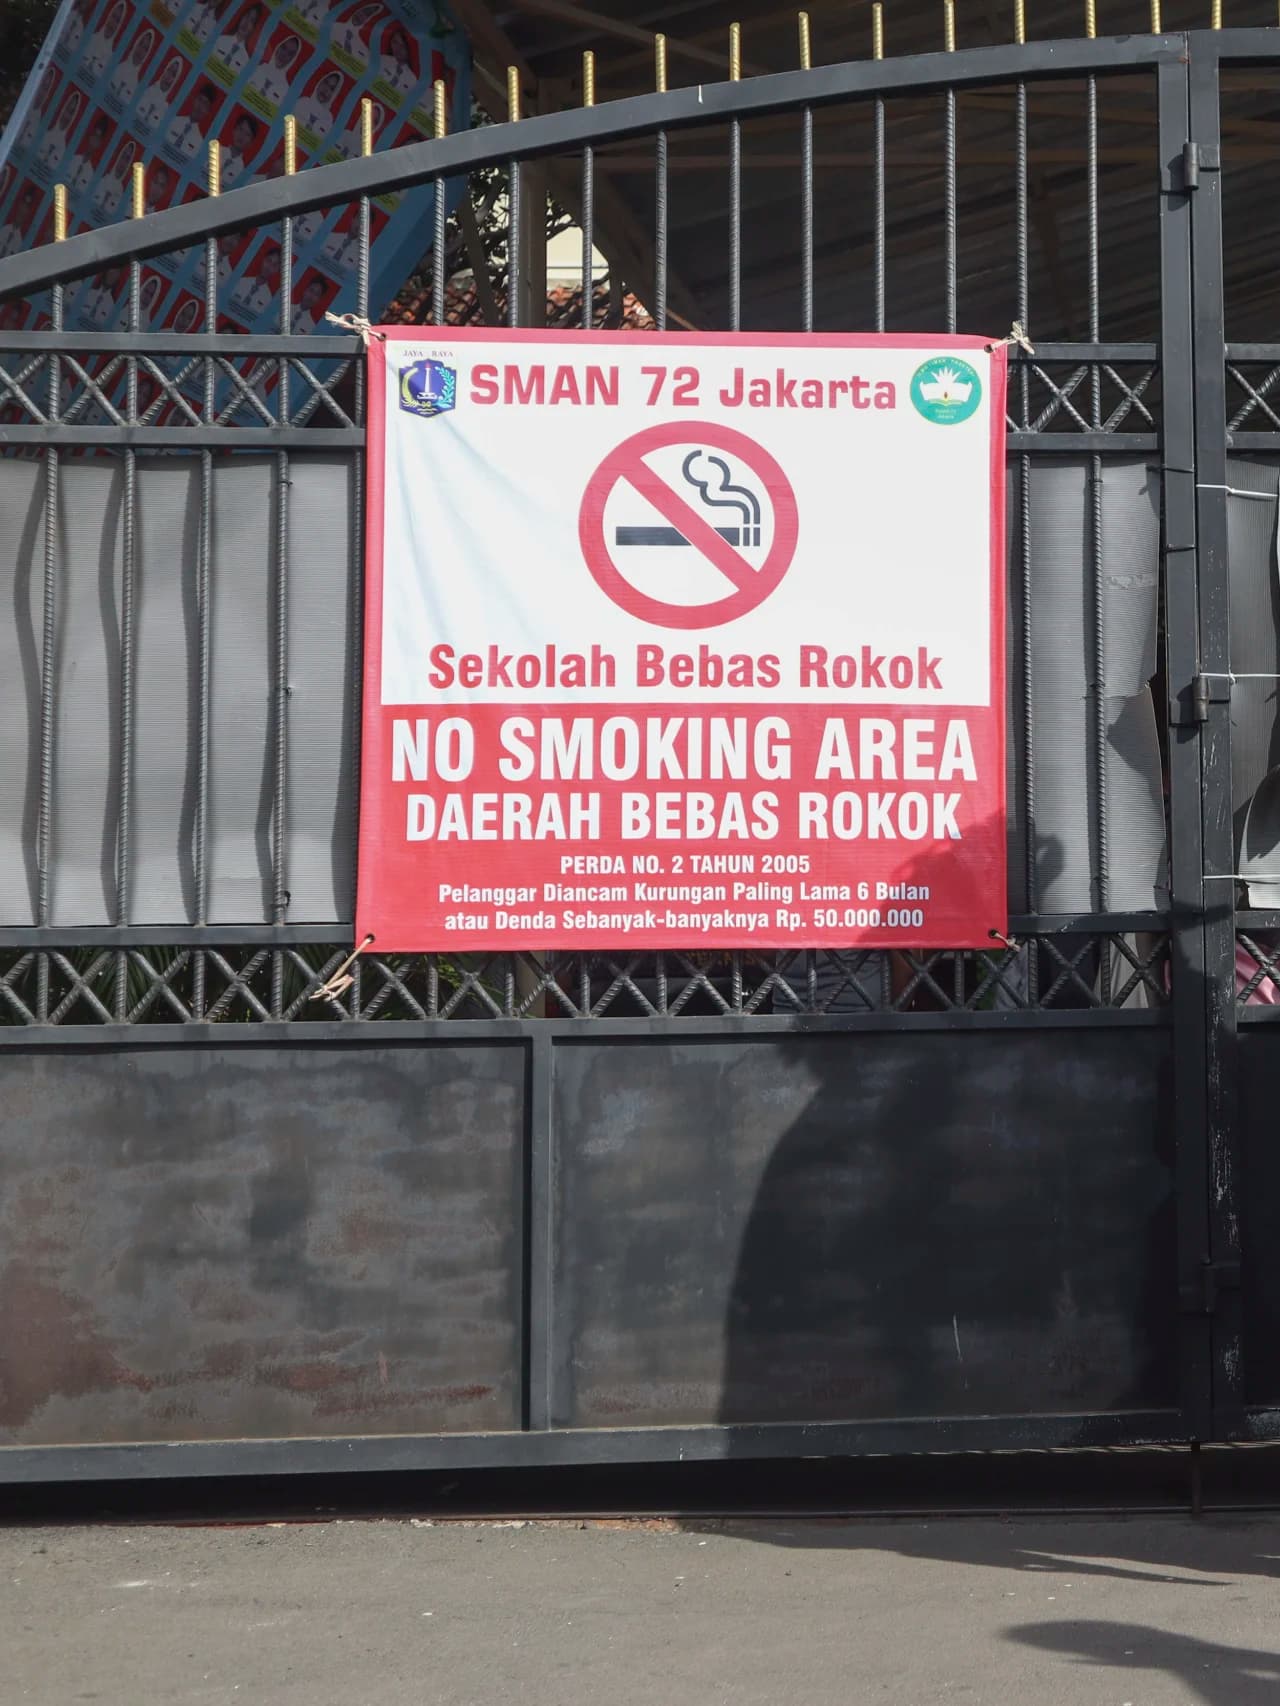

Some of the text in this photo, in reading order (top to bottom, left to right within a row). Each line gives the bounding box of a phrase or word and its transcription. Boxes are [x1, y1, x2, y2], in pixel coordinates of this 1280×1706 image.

[403, 349, 454, 357] JAYA RAYA
[470, 363, 620, 407] SMAN
[640, 365, 700, 407] 72
[719, 367, 896, 410] Jakarta
[428, 643, 943, 690] Sekolah Bebas Rokok
[391, 715, 979, 783] NO SMOKING AREA
[405, 790, 963, 842] DAERAH BEBAS ROKOK
[560, 854, 810, 875] PERDA NO. 2 TAHUN 2005
[438, 881, 930, 907] Pelanggar Diancam Kurungan Paling Lama 6 Bulan
[444, 908, 924, 933] atau Denda Sebanyak-banyaknya Rp. 50.000.000
